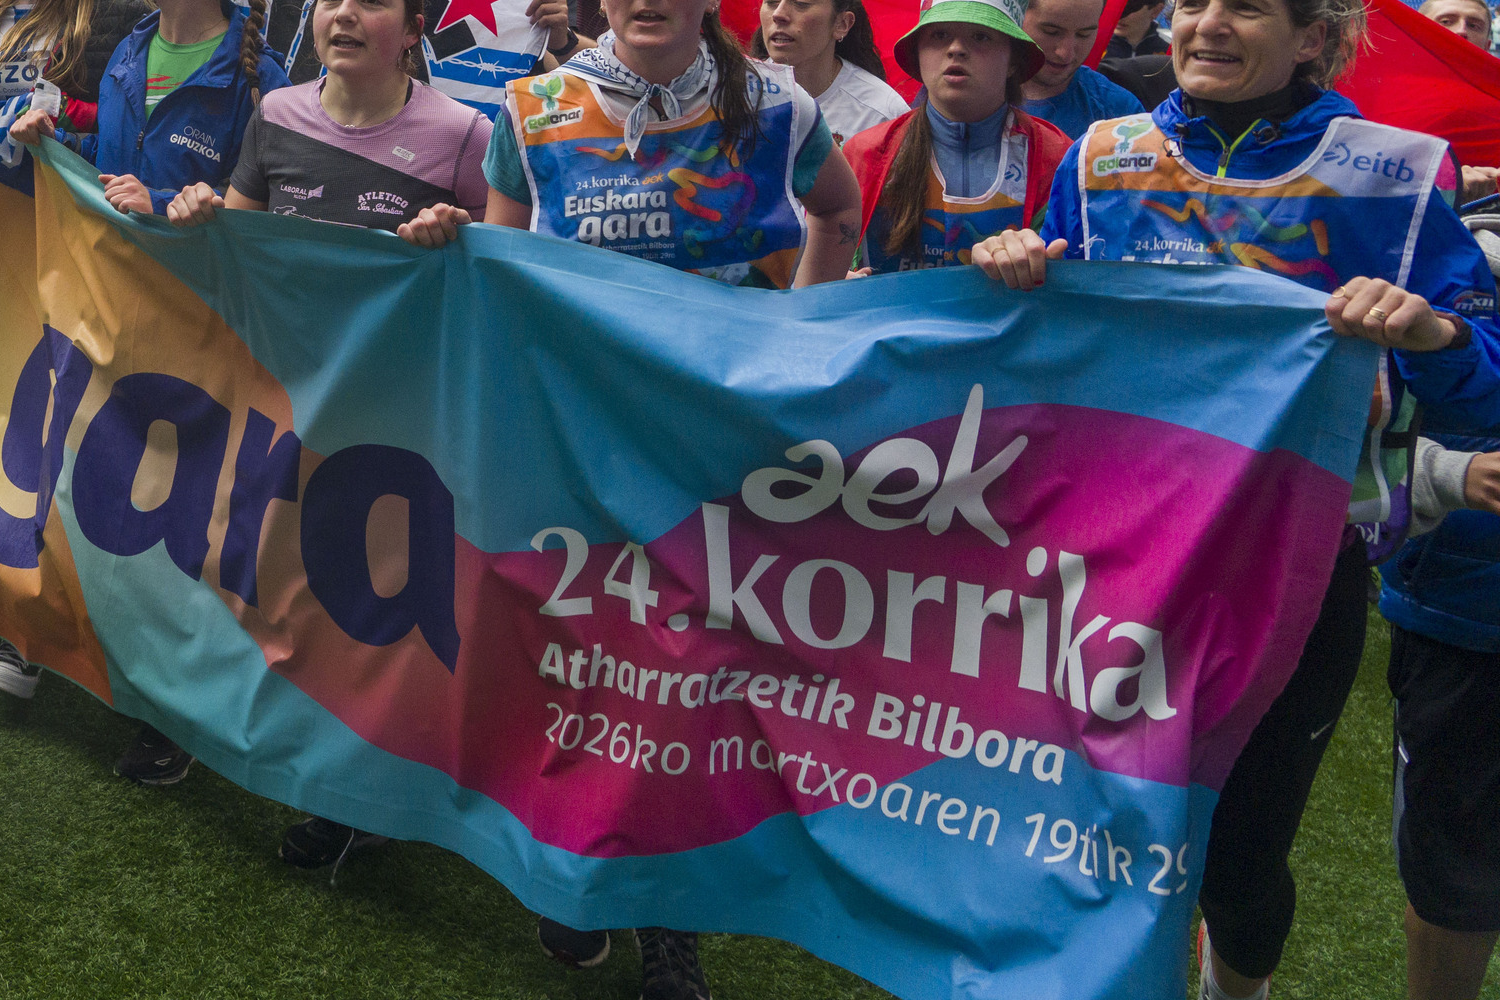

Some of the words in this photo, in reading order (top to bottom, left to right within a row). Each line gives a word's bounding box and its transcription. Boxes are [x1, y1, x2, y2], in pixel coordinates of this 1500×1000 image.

[749, 74, 781, 95] itb
[169, 133, 221, 163] GIPUZKOA
[183, 125, 216, 147] ORAIN
[575, 174, 639, 191] 24.korrika
[641, 171, 665, 185] aek
[1353, 151, 1415, 184] eitb
[280, 184, 308, 196] LABORAL
[357, 191, 409, 209] ATLETICO
[564, 189, 667, 218] Euskara
[577, 211, 672, 247] gara
[1134, 236, 1204, 253] 24.korrika
[741, 383, 1028, 548] aek
[530, 501, 1178, 722] 24.korrika
[538, 642, 855, 731] Atharratzetik
[867, 692, 1068, 786] Bilbora
[544, 702, 691, 777] 2026ko
[708, 735, 1002, 848] martxoaren
[1025, 812, 1133, 886] 19tik
